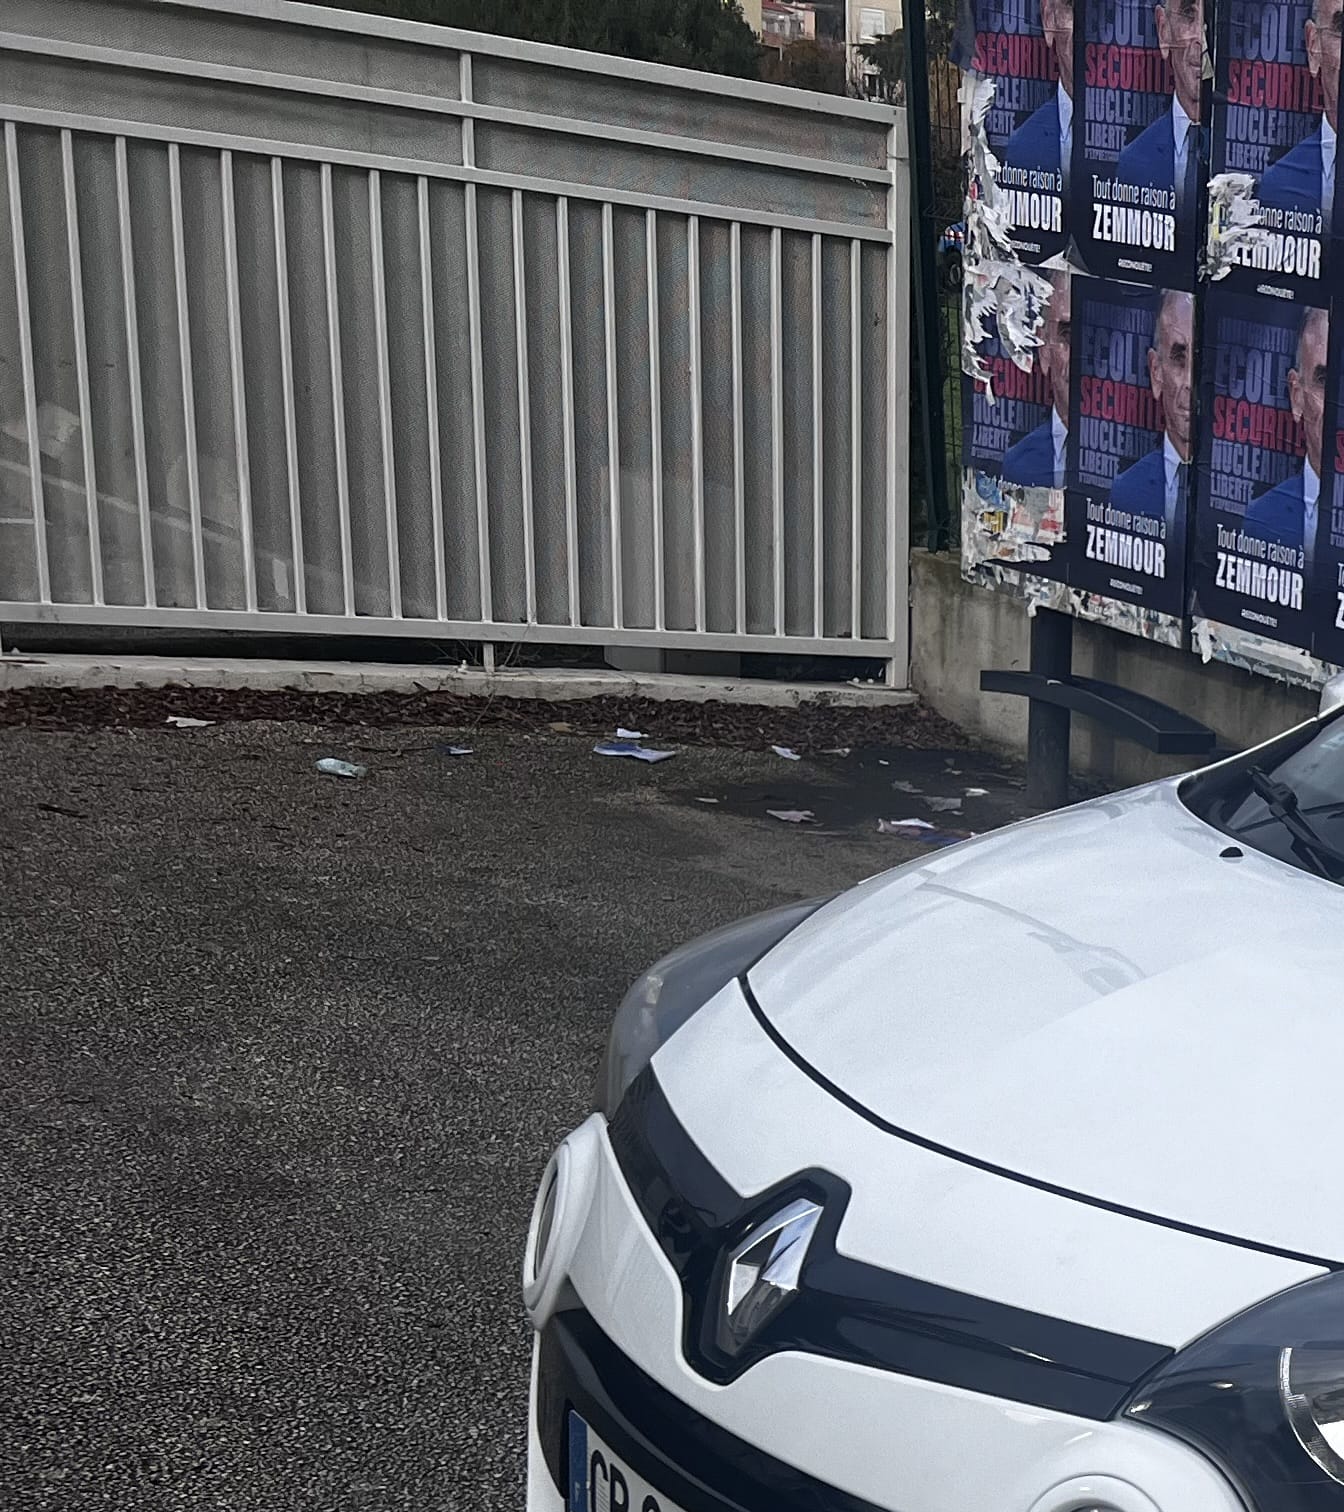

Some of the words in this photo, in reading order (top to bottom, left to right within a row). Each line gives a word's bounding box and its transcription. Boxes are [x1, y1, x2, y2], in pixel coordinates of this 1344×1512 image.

[1084, 43, 1175, 95] SECURITE
[1227, 59, 1325, 114] SECURITE
[1003, 161, 1027, 187] donne
[1029, 165, 1055, 191] raison
[1056, 168, 1062, 192] à
[1092, 174, 1111, 200] Tout
[1112, 177, 1139, 204] donne
[1140, 181, 1168, 209] raison
[1169, 184, 1176, 210] à
[1003, 188, 1062, 232] MMOUR
[1093, 203, 1176, 252] ZEMMOUR
[1284, 204, 1314, 233] raison
[1315, 207, 1322, 234] à
[1080, 376, 1165, 432] SECURITE
[1212, 395, 1305, 456] SECURITE
[1086, 497, 1104, 523] Tout
[1105, 502, 1131, 531] donne
[1132, 511, 1159, 537] raison
[1160, 515, 1166, 539] à
[1086, 523, 1166, 578] ZEMMOUR
[1217, 523, 1236, 551] Tout
[1237, 529, 1266, 558] donne
[1267, 538, 1296, 567] raison
[1297, 545, 1304, 569] à
[1215, 552, 1304, 610] ZEMMOUR
